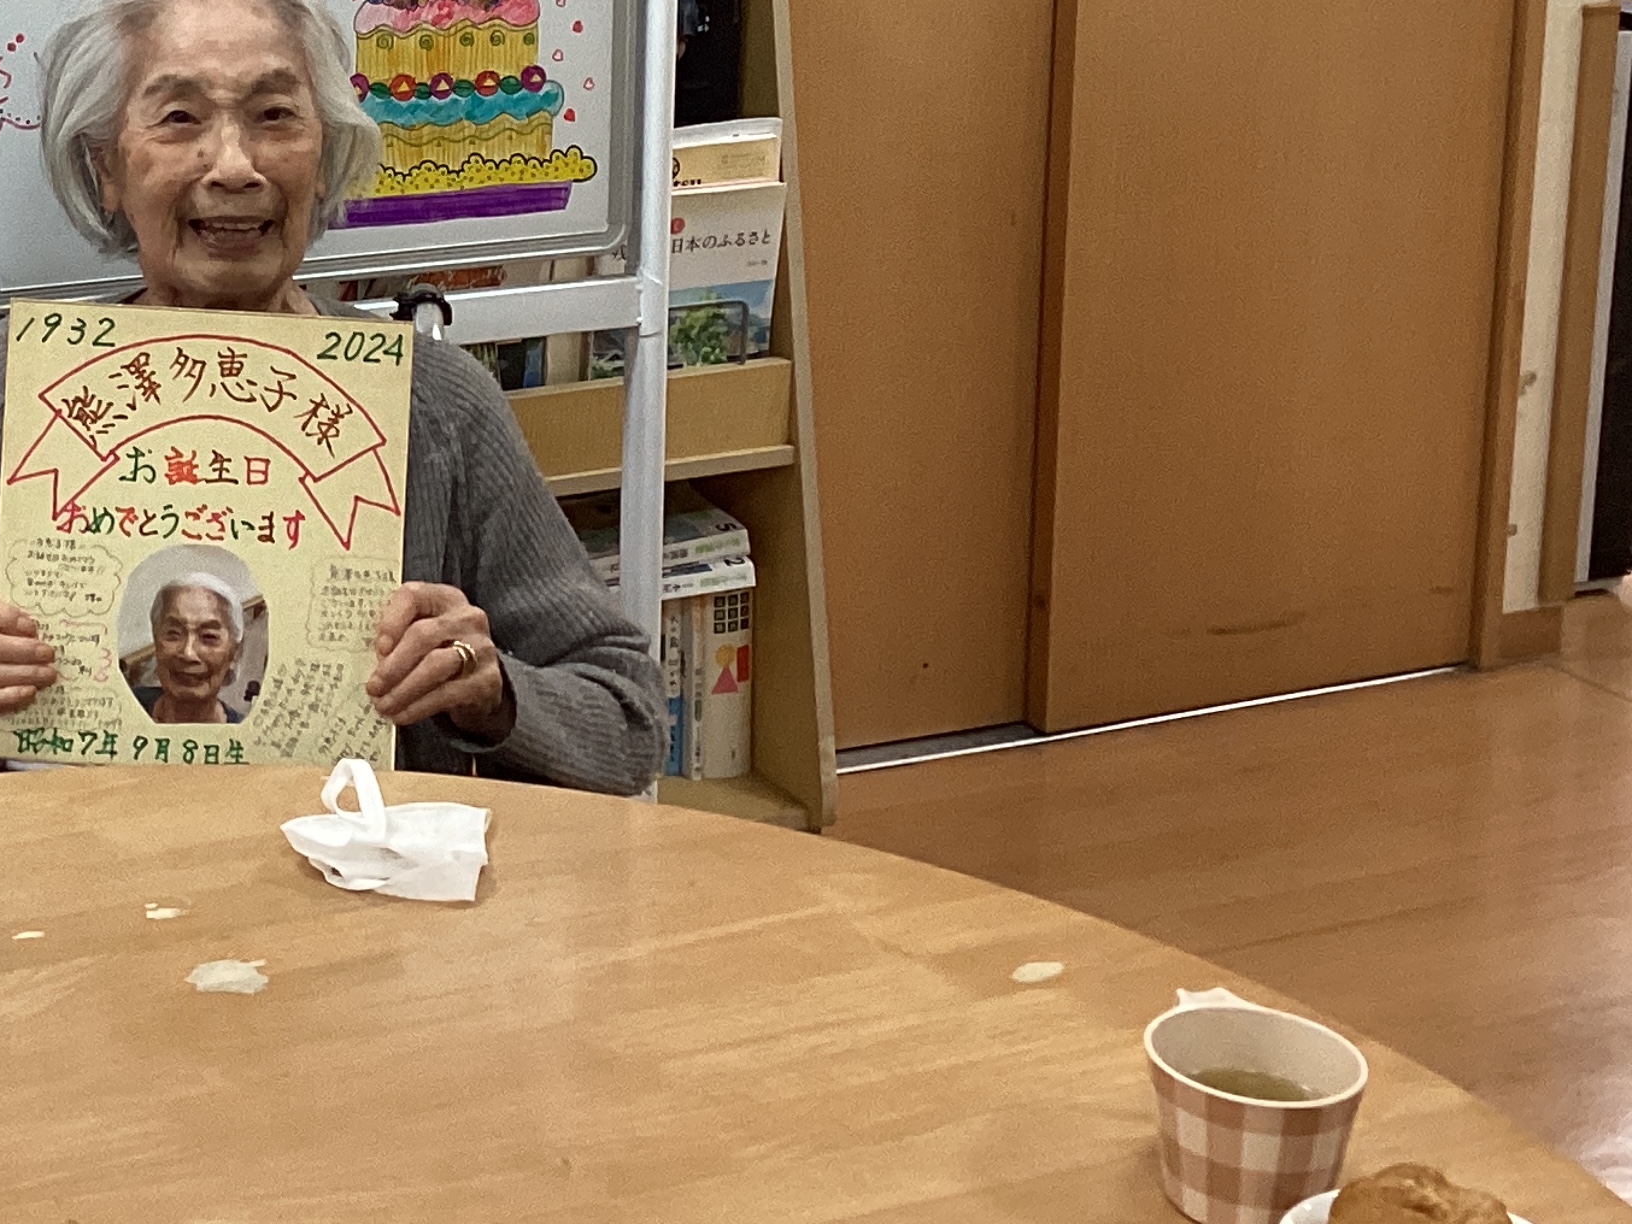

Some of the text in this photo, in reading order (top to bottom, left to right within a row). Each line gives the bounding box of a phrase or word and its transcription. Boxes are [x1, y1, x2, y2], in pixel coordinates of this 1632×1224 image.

[671, 228, 772, 254] 日本のふるさと
[16, 313, 116, 347] 1932
[317, 331, 404, 366] 2024
[61, 346, 353, 458] 熊澤多恵子様
[119, 445, 270, 486] お誕生日
[57, 500, 306, 550] おめでとうございます
